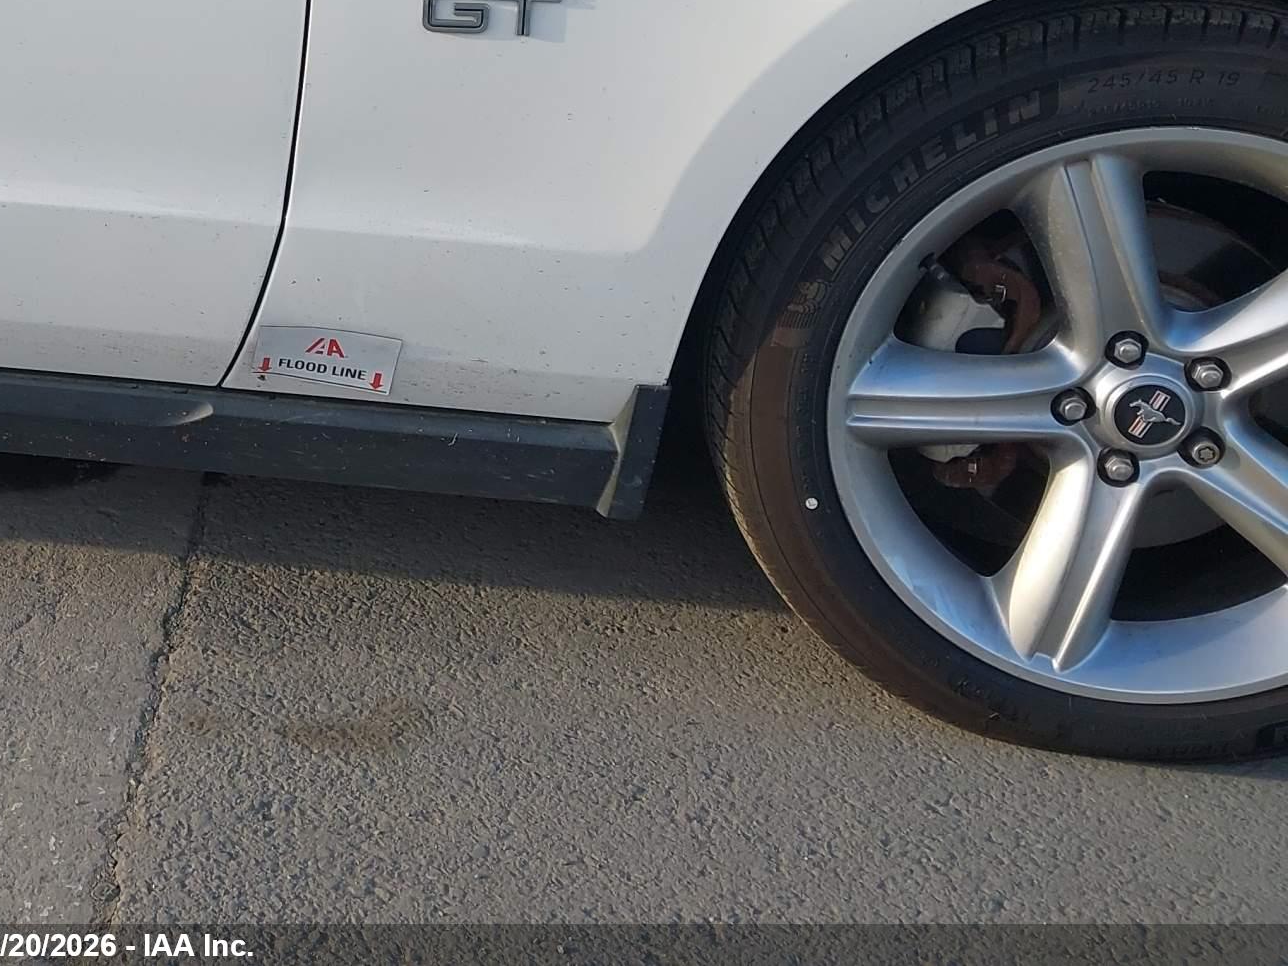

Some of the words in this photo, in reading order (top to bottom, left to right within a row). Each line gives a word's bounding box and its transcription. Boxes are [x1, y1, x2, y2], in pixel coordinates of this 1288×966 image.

[1087, 68, 1178, 94] 245/45
[1189, 67, 1205, 85] R
[1217, 70, 1241, 86] 19
[815, 89, 1041, 273] MICHELIN
[278, 358, 328, 374] FLOOD
[331, 365, 368, 381] LINE
